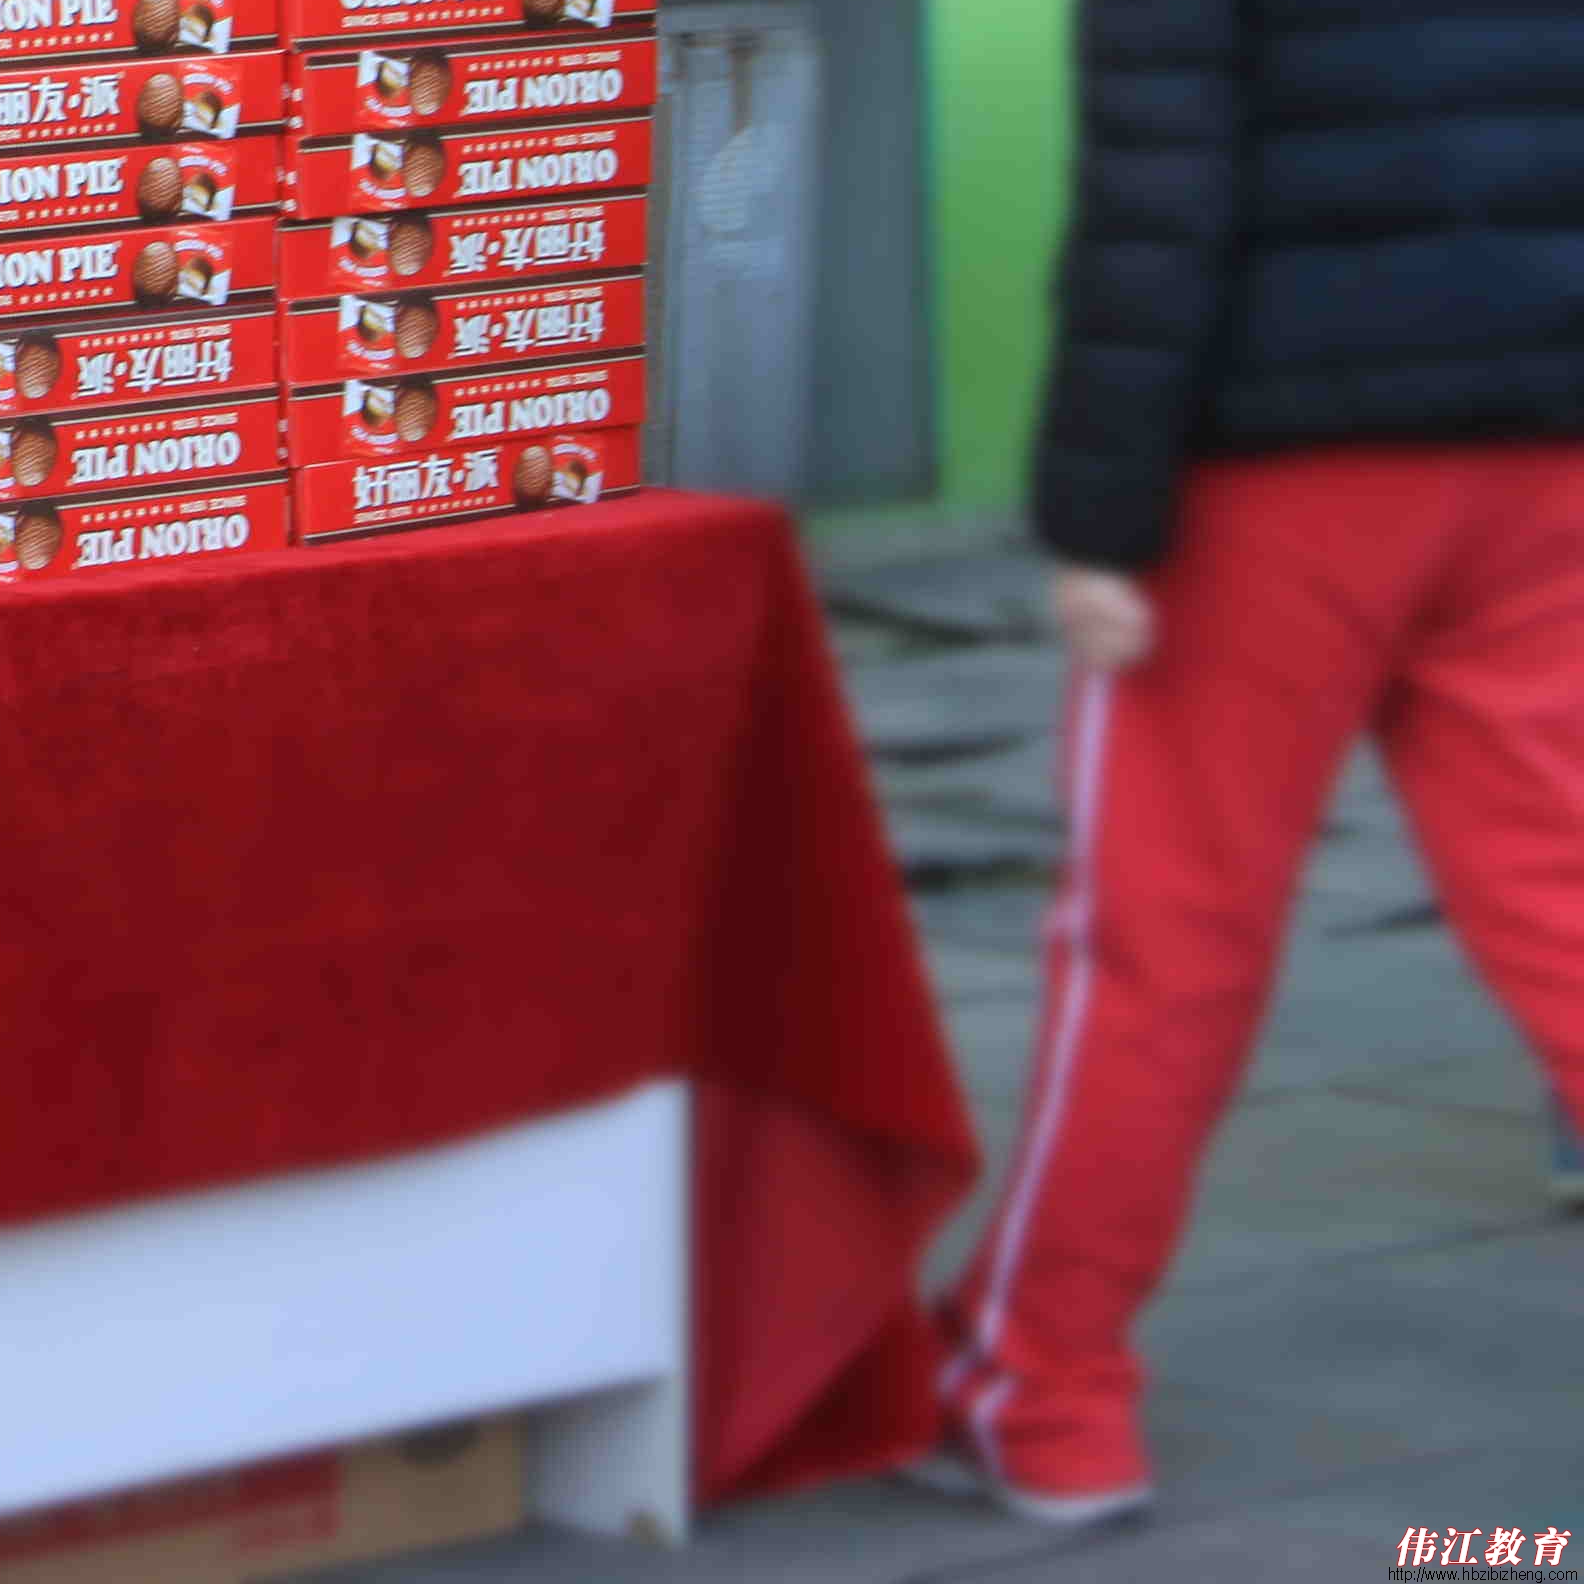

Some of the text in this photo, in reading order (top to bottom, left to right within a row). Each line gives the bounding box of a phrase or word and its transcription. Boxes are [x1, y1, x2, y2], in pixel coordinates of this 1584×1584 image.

[462, 68, 623, 116] ORION PIE
[63, 157, 125, 197] PIE
[457, 148, 617, 197] ORION PIE
[57, 241, 120, 282] PIE
[450, 388, 610, 441] ORION PIE
[70, 431, 241, 486] ORION PIE
[75, 514, 249, 568] ORION PIE
